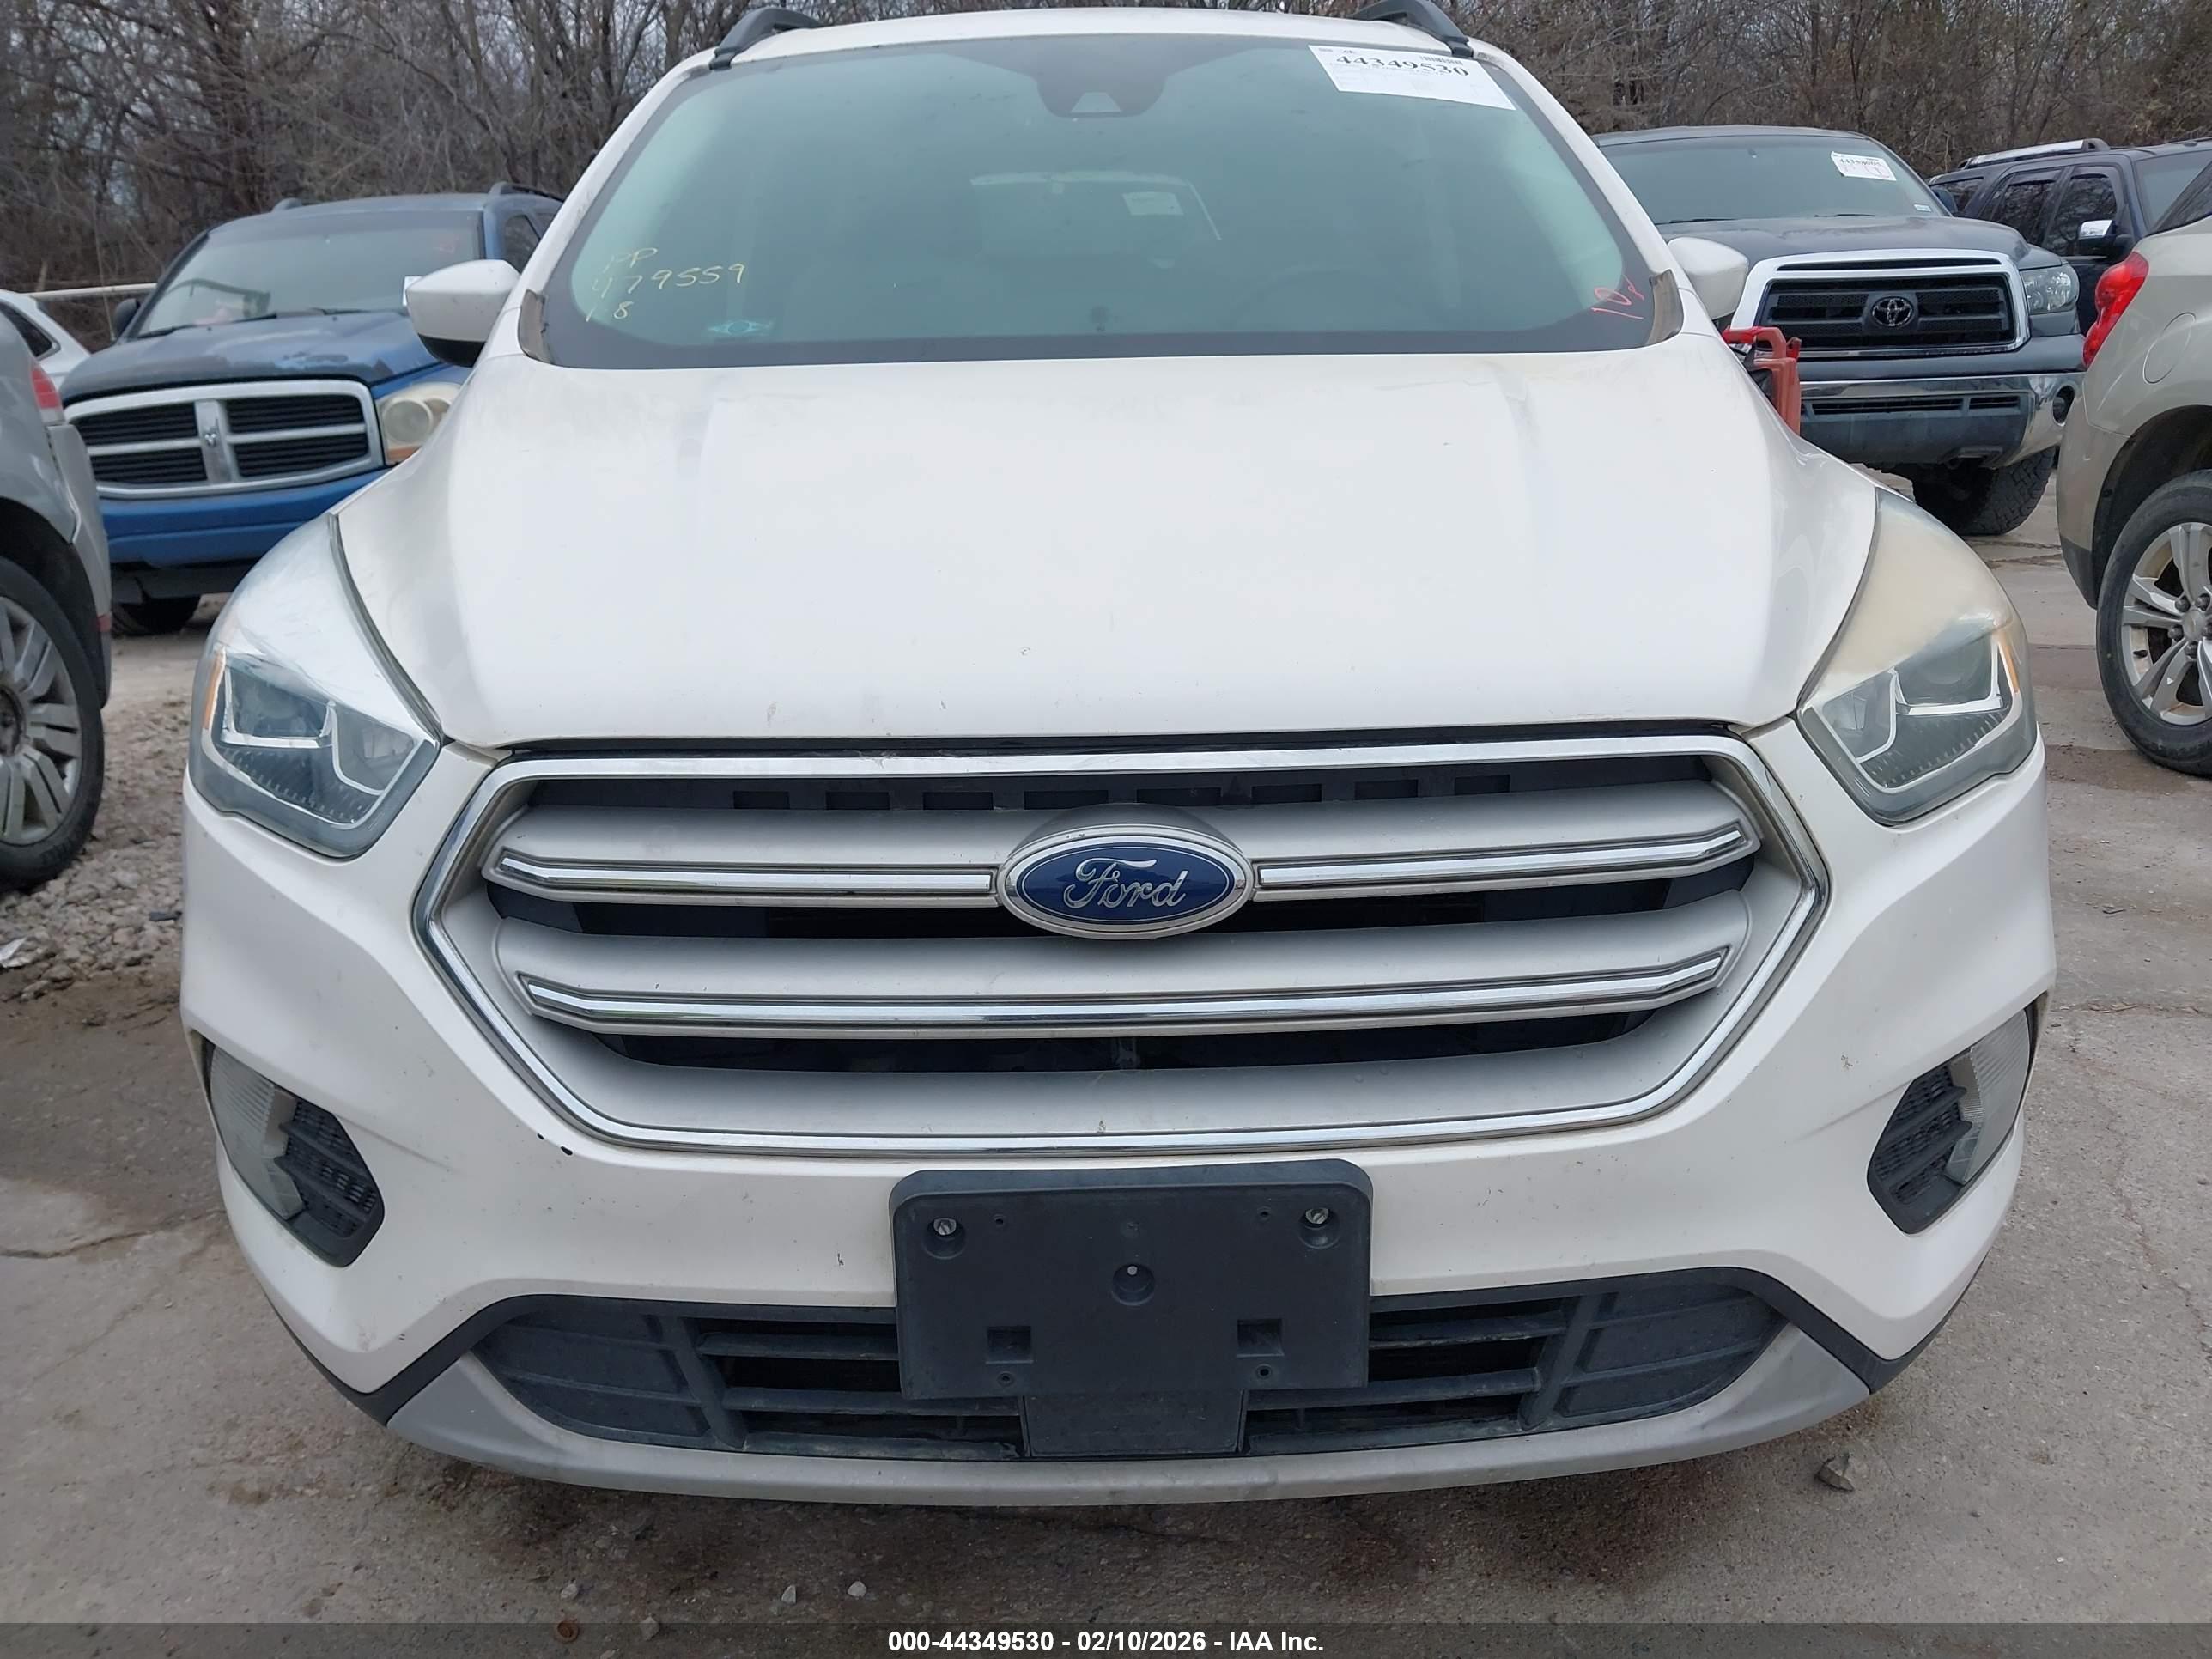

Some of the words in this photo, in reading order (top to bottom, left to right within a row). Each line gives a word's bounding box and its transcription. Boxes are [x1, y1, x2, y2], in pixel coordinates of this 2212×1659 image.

[1336, 55, 1469, 76] 44349530
[592, 263, 745, 298] 479559
[1063, 857, 1189, 908] Ford
